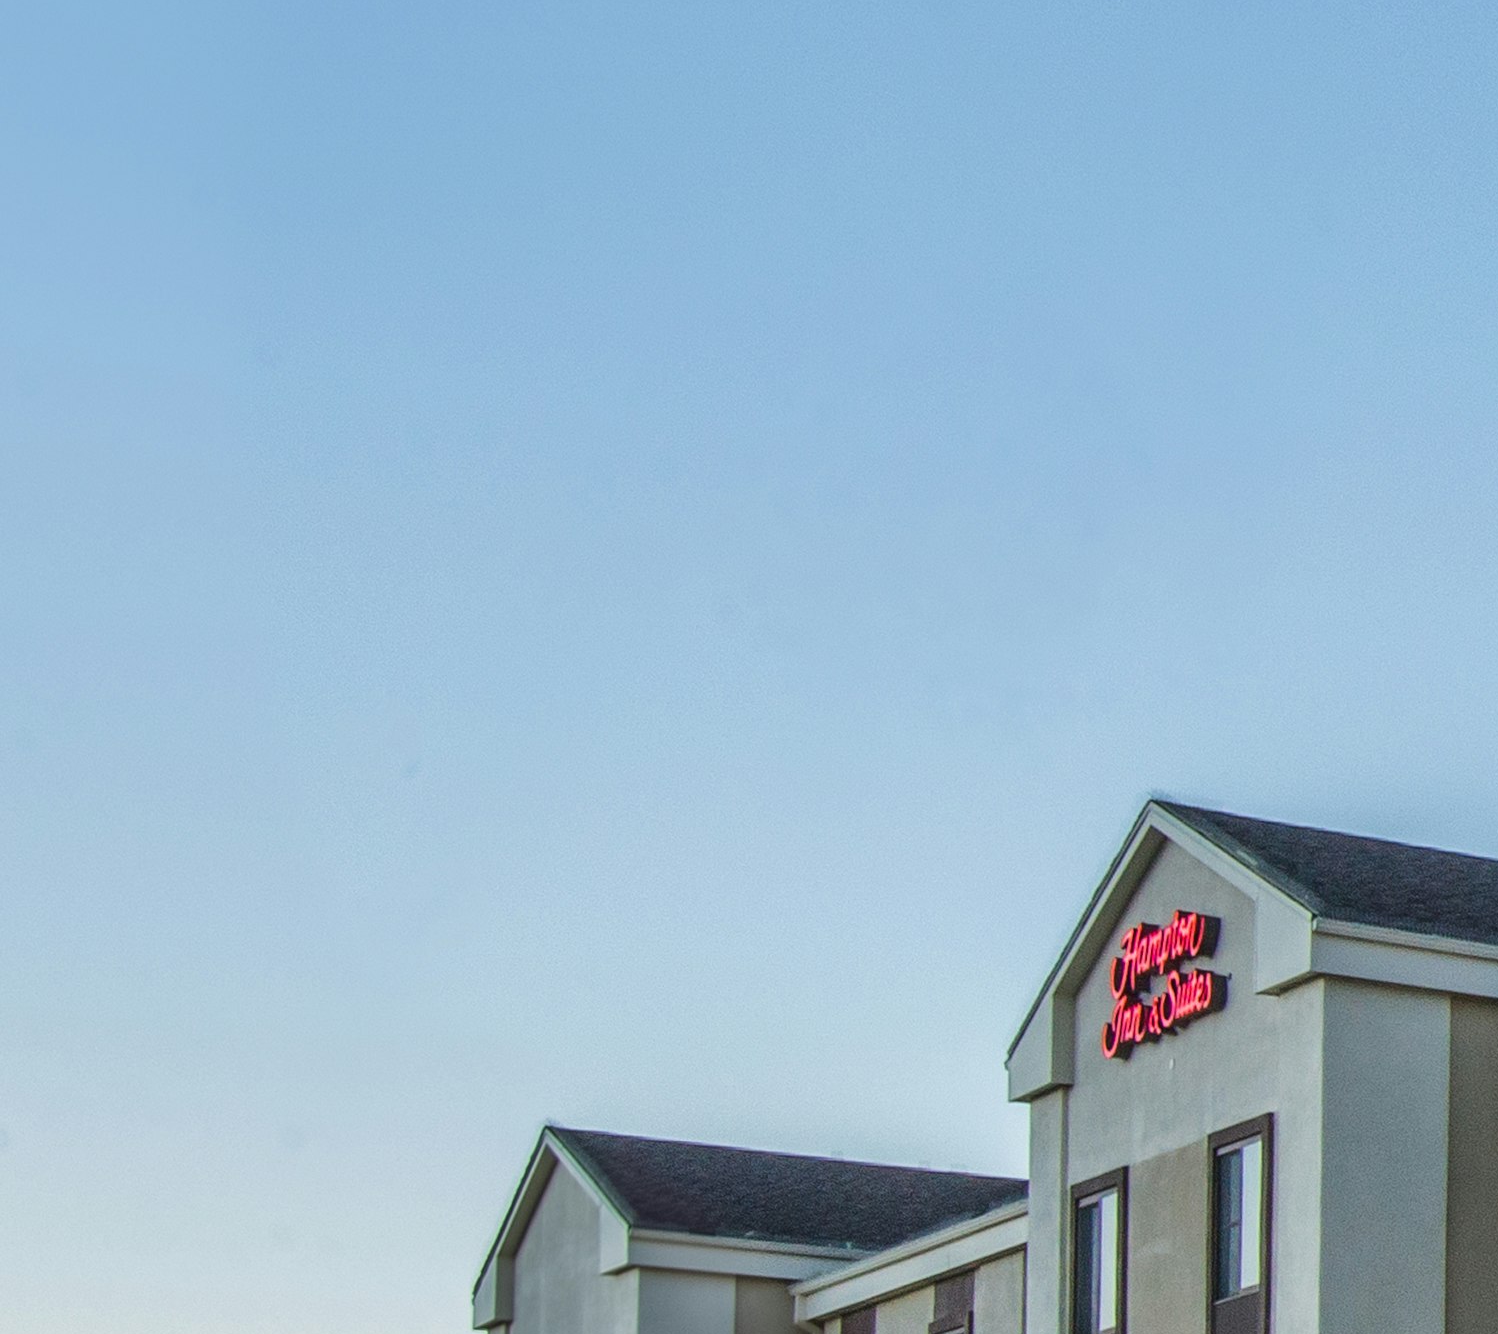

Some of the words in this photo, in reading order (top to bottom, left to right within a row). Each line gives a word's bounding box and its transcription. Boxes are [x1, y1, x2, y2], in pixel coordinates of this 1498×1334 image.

[1110, 909, 1206, 1000] Hampton
[1101, 995, 1148, 1059] Inn
[1160, 968, 1213, 1028] Suites
